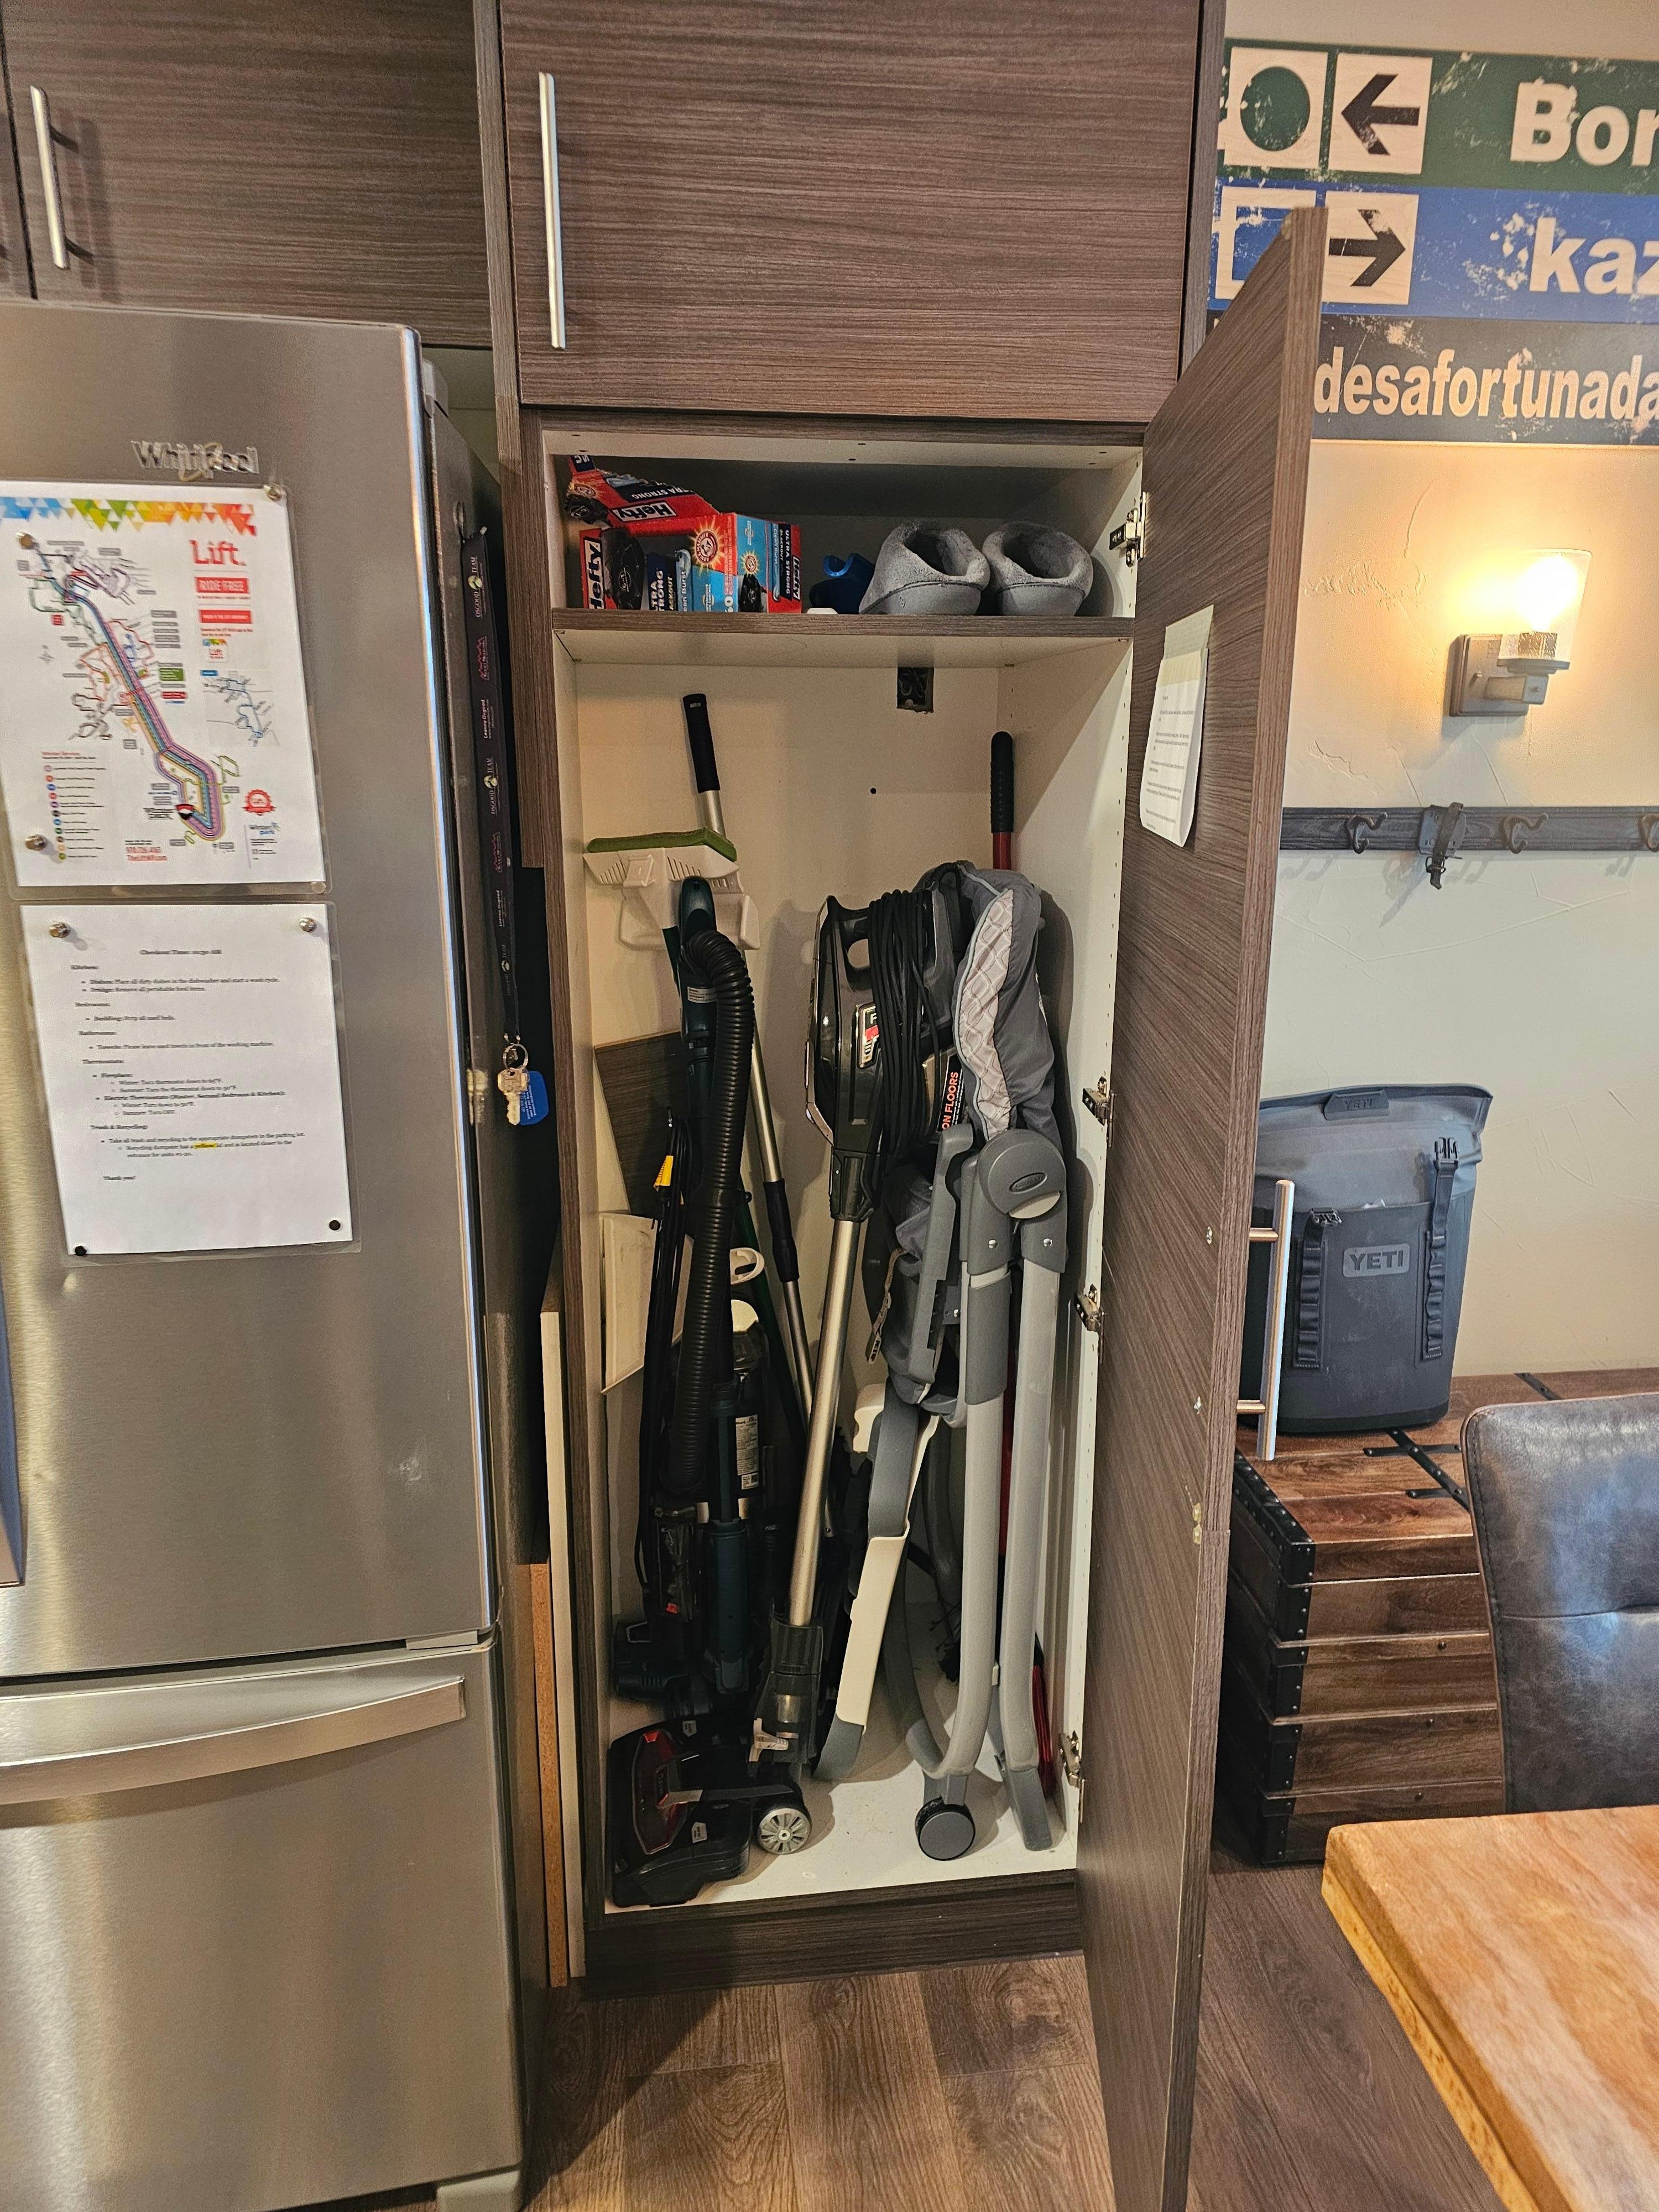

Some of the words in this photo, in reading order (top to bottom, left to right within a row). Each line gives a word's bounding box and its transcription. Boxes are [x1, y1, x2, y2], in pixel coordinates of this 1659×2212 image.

[1314, 346, 1659, 421] desafortunada
[131, 441, 259, 481] Whirlpool
[632, 489, 668, 499] STRONG
[617, 503, 672, 519] Hefty
[656, 570, 665, 611] TRONG
[945, 1072, 959, 1113] FLOORS
[941, 1115, 951, 1130] ON
[1349, 1250, 1404, 1270] YETI
